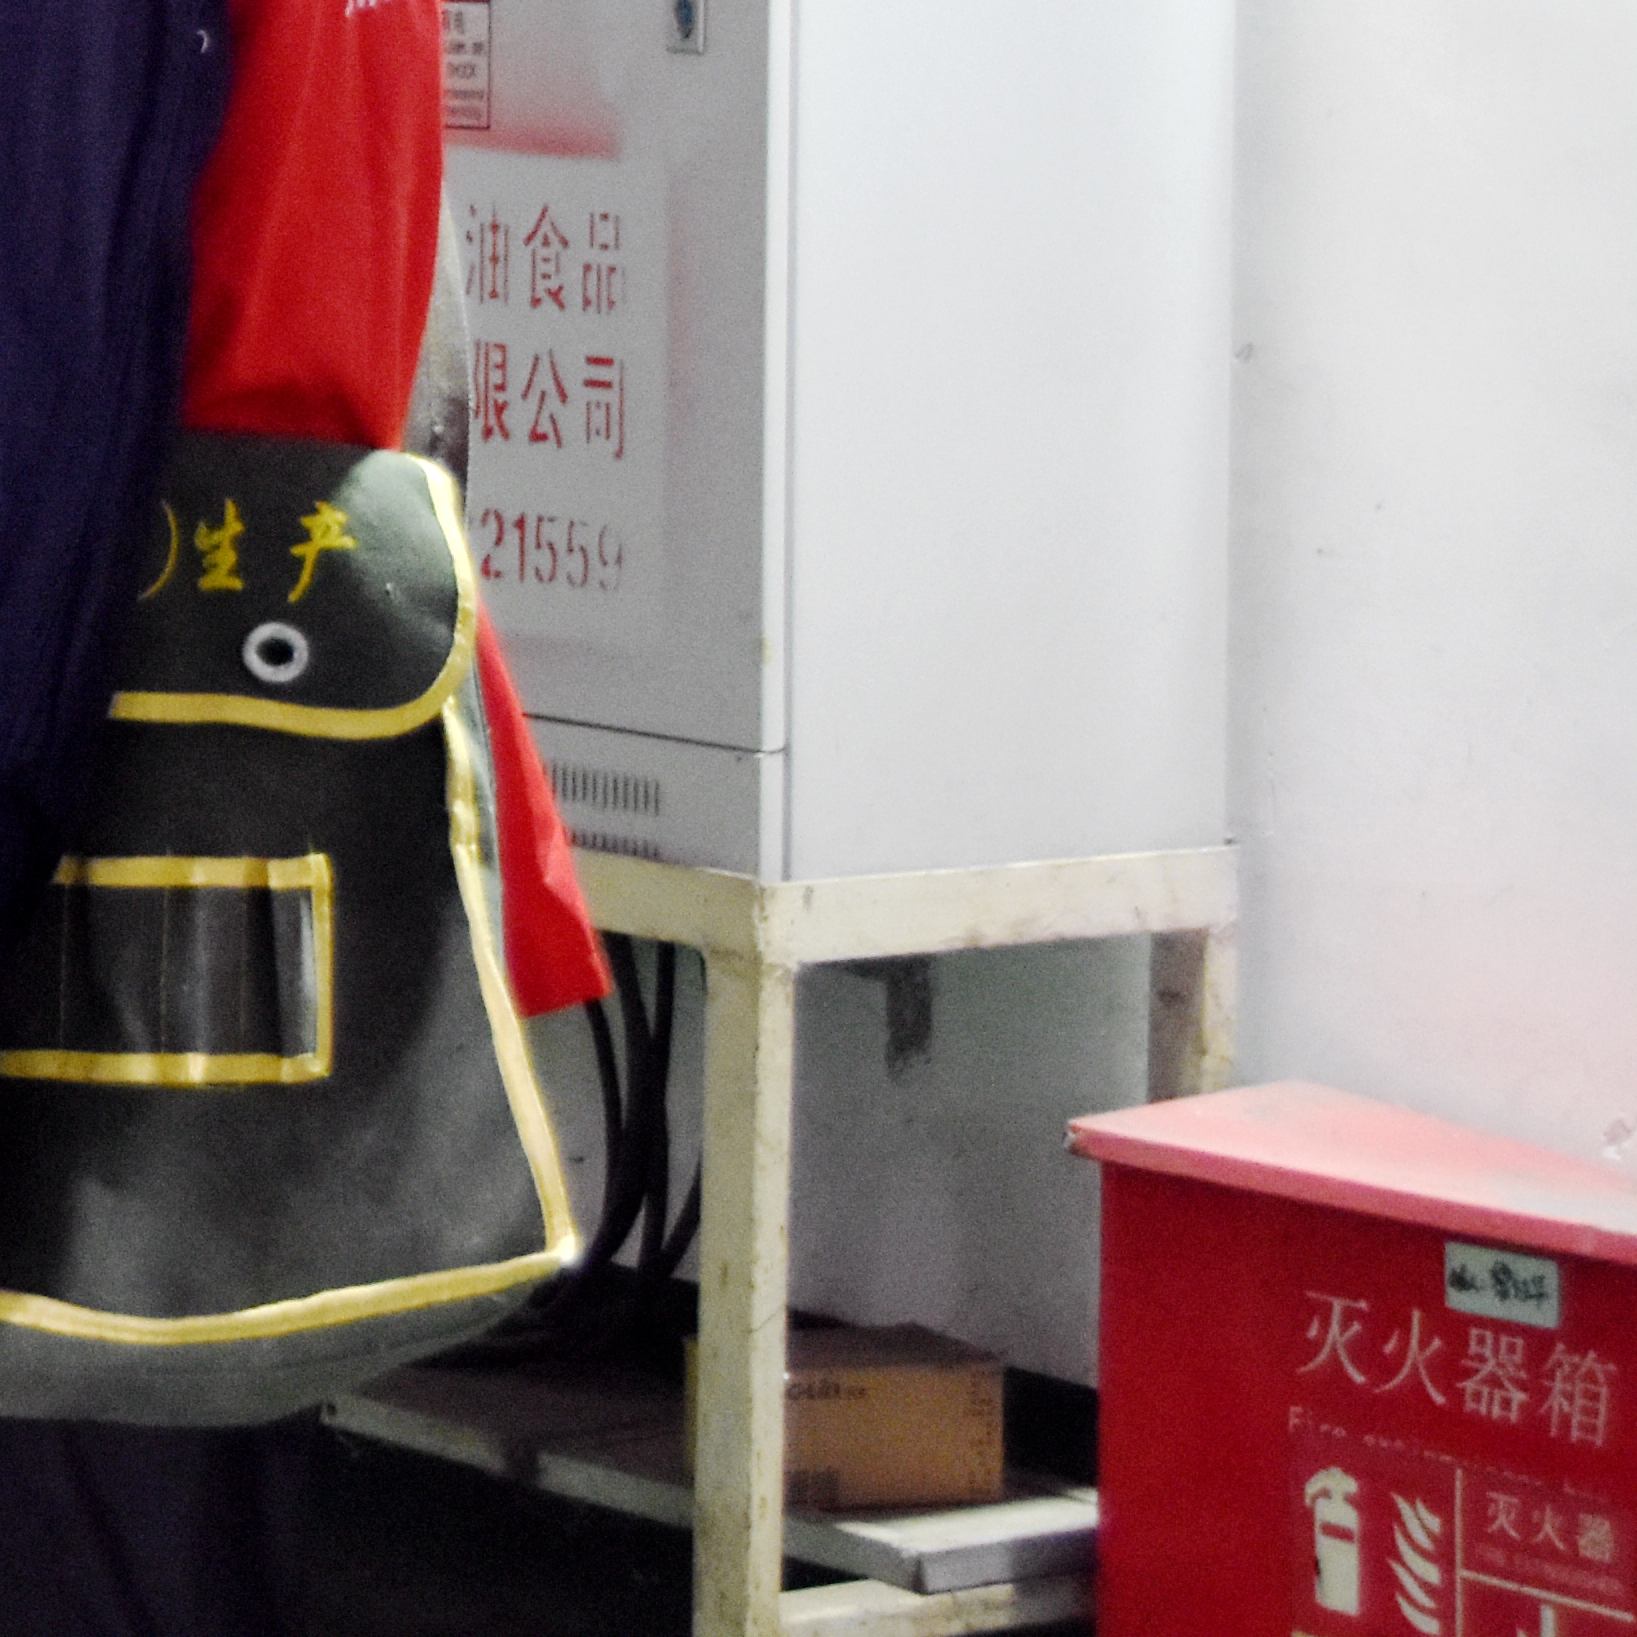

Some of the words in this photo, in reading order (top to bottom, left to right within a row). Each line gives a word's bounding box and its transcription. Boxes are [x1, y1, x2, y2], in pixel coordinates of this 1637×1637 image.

[466, 203, 622, 311] 油食品
[473, 339, 624, 459] 限公司
[1295, 1289, 1619, 1449] 灭火器箱
